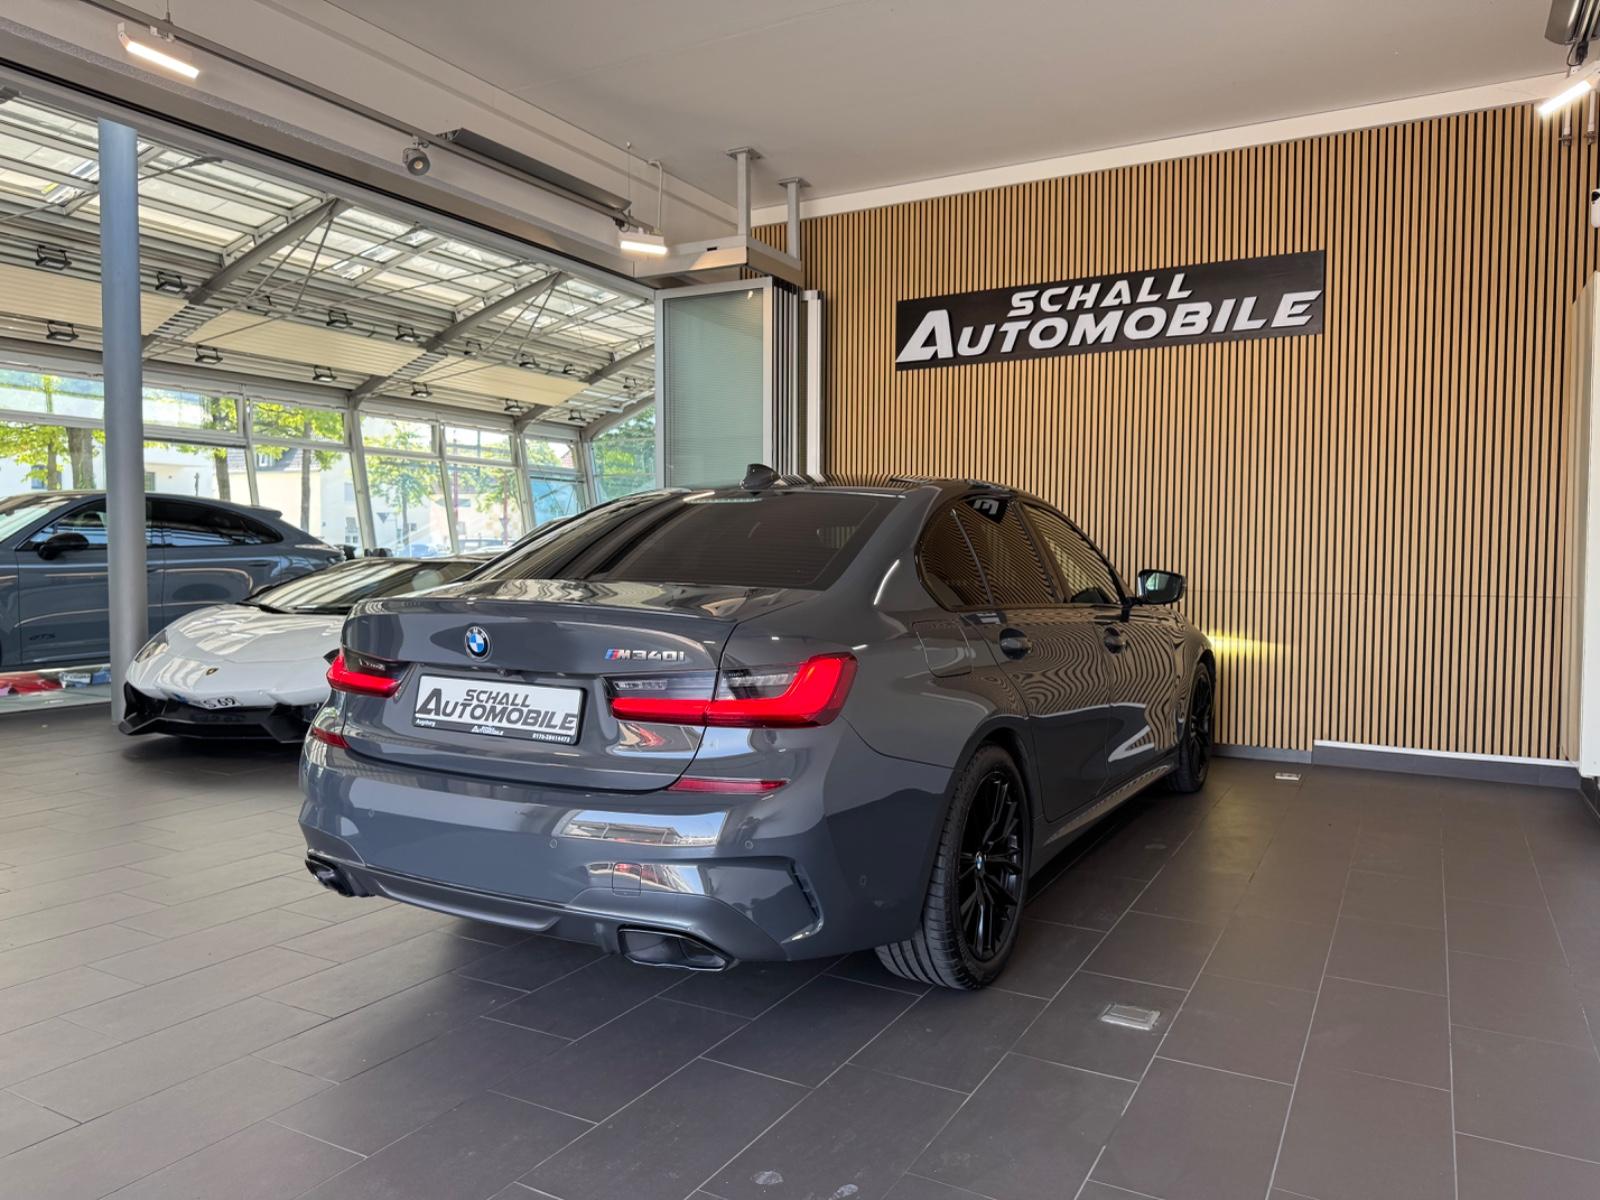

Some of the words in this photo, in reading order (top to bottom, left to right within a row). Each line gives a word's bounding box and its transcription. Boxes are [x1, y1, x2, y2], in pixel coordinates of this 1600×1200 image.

[1007, 273, 1194, 318] SCHALL
[895, 289, 1322, 364] AUTOMOBILE
[416, 688, 579, 730] AUTOMOBILE
[463, 689, 531, 708] SCHALL
